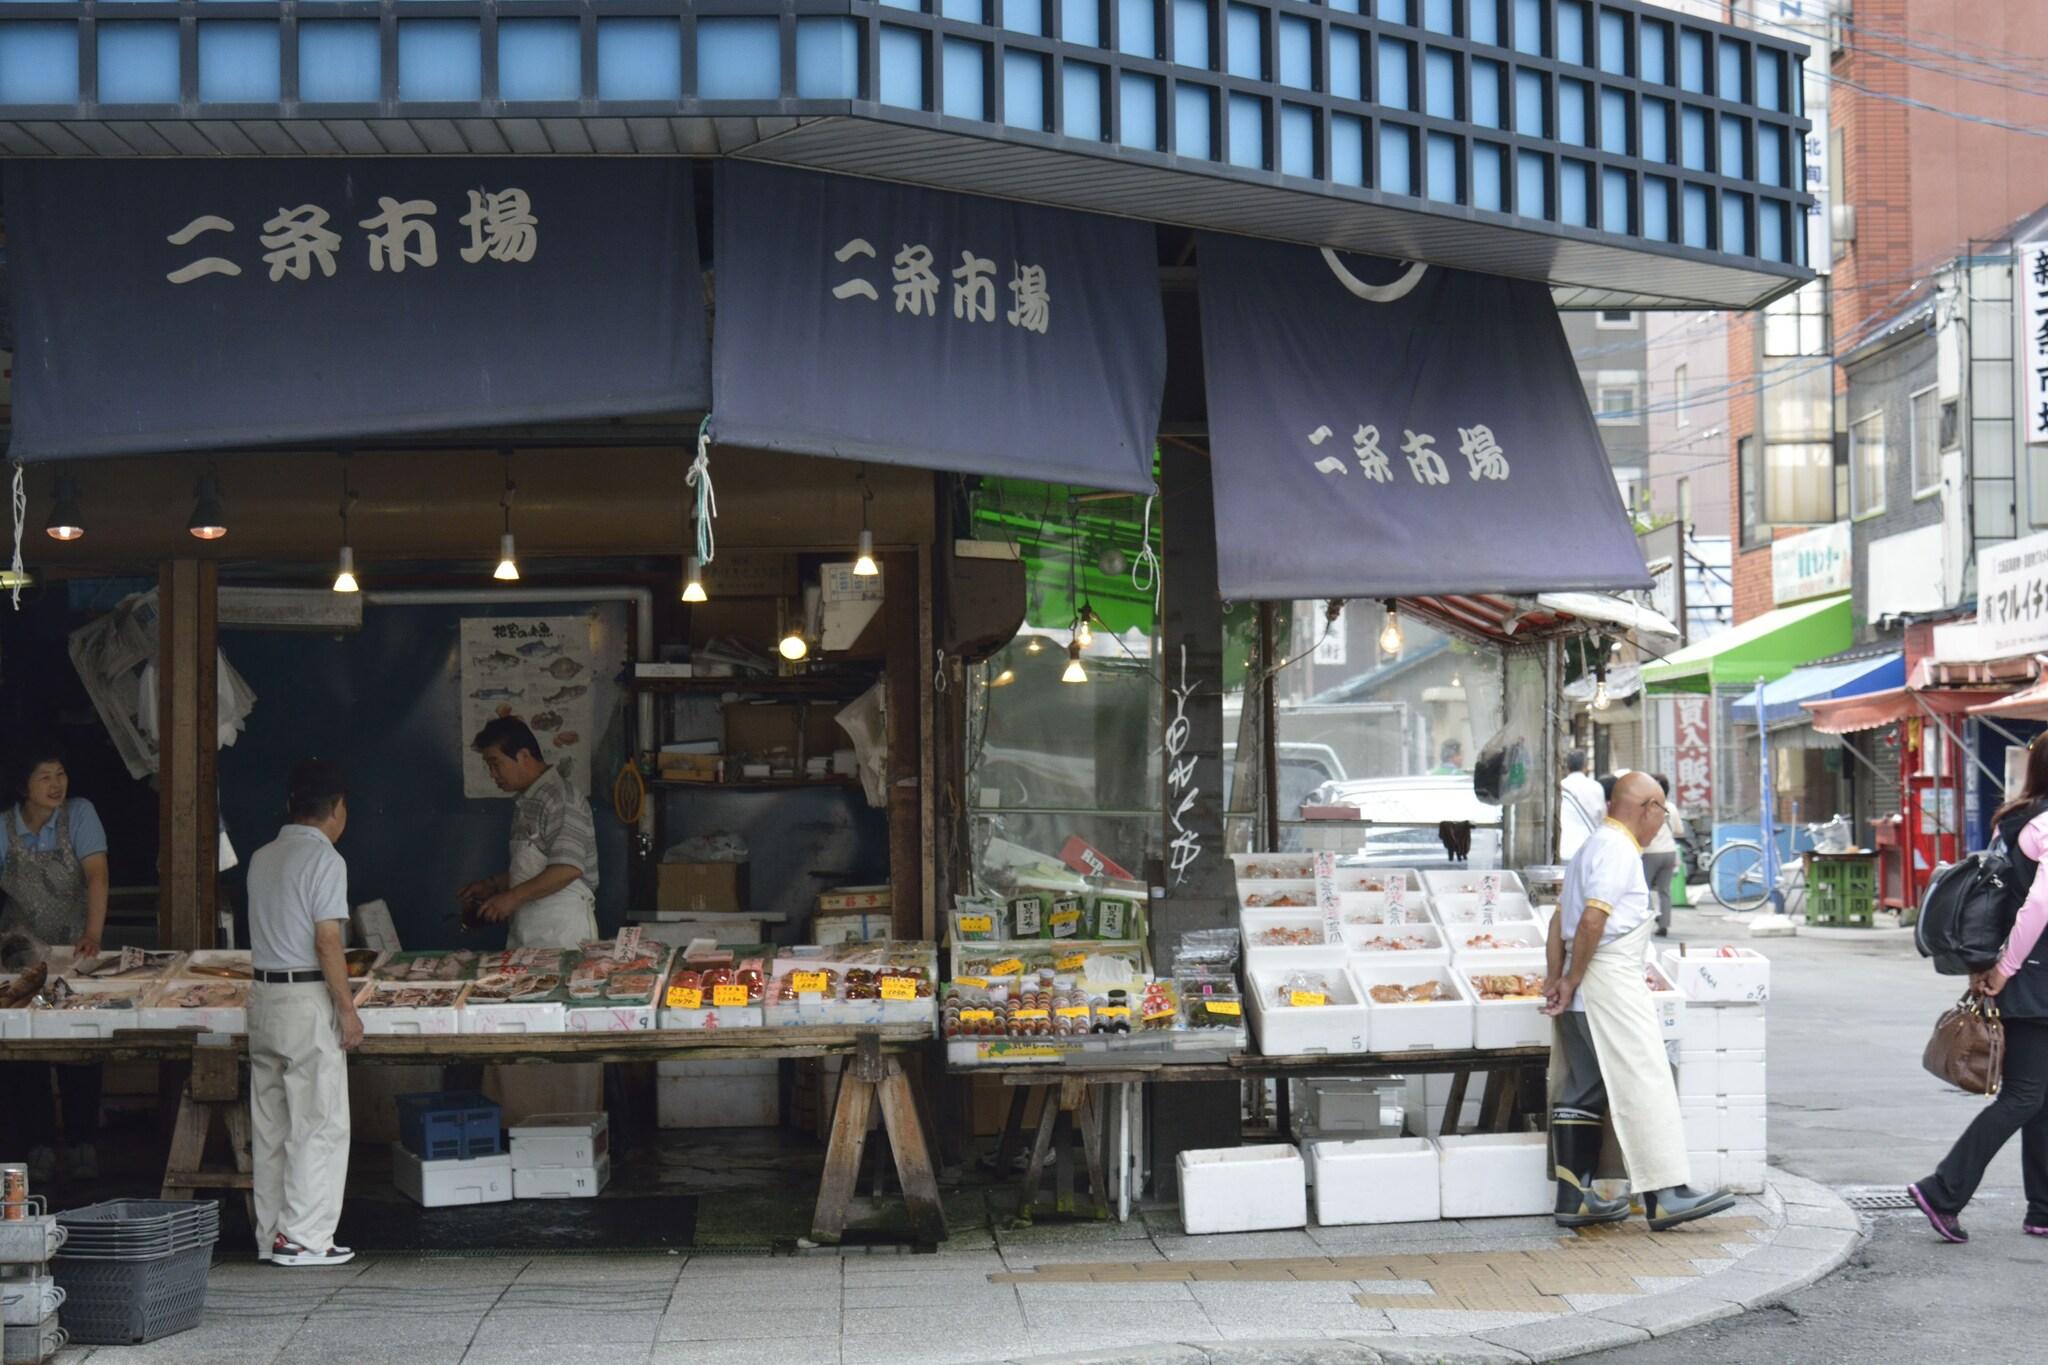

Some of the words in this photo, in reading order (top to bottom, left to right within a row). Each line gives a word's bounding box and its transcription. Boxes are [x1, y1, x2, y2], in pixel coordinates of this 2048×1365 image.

[164, 186, 540, 284] 二条市場
[832, 238, 1051, 335] 二条市場
[1307, 423, 1511, 486] 二条市場
[1997, 578, 2048, 625] マルイチ
